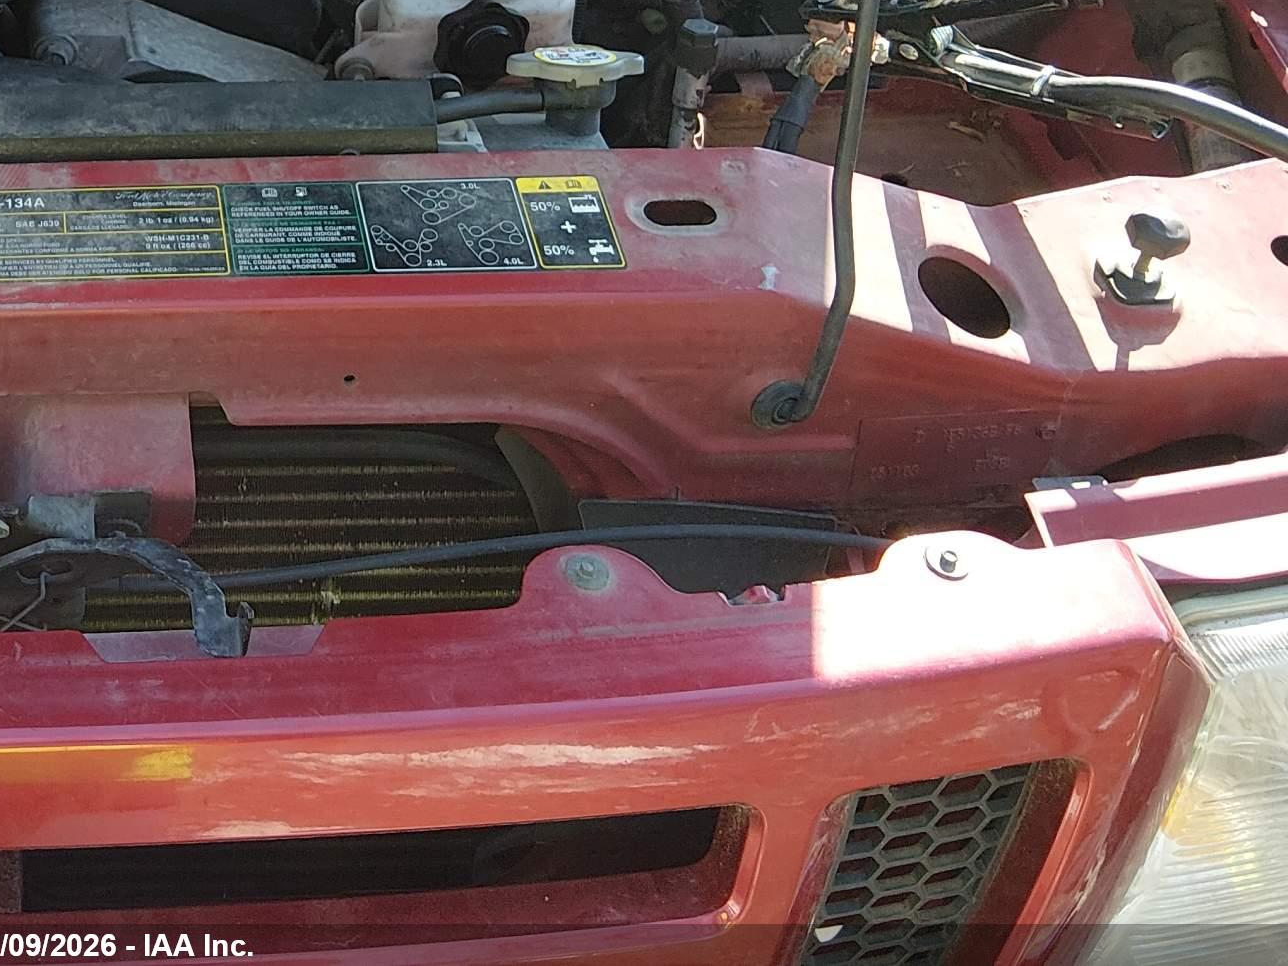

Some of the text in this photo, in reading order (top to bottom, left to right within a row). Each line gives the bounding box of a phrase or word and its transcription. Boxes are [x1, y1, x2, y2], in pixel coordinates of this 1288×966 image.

[530, 201, 561, 212] 50%
[15, 220, 36, 228] SAE
[543, 245, 574, 256] 50%
[426, 259, 448, 267] 2.3L
[503, 257, 524, 265] 4.0L
